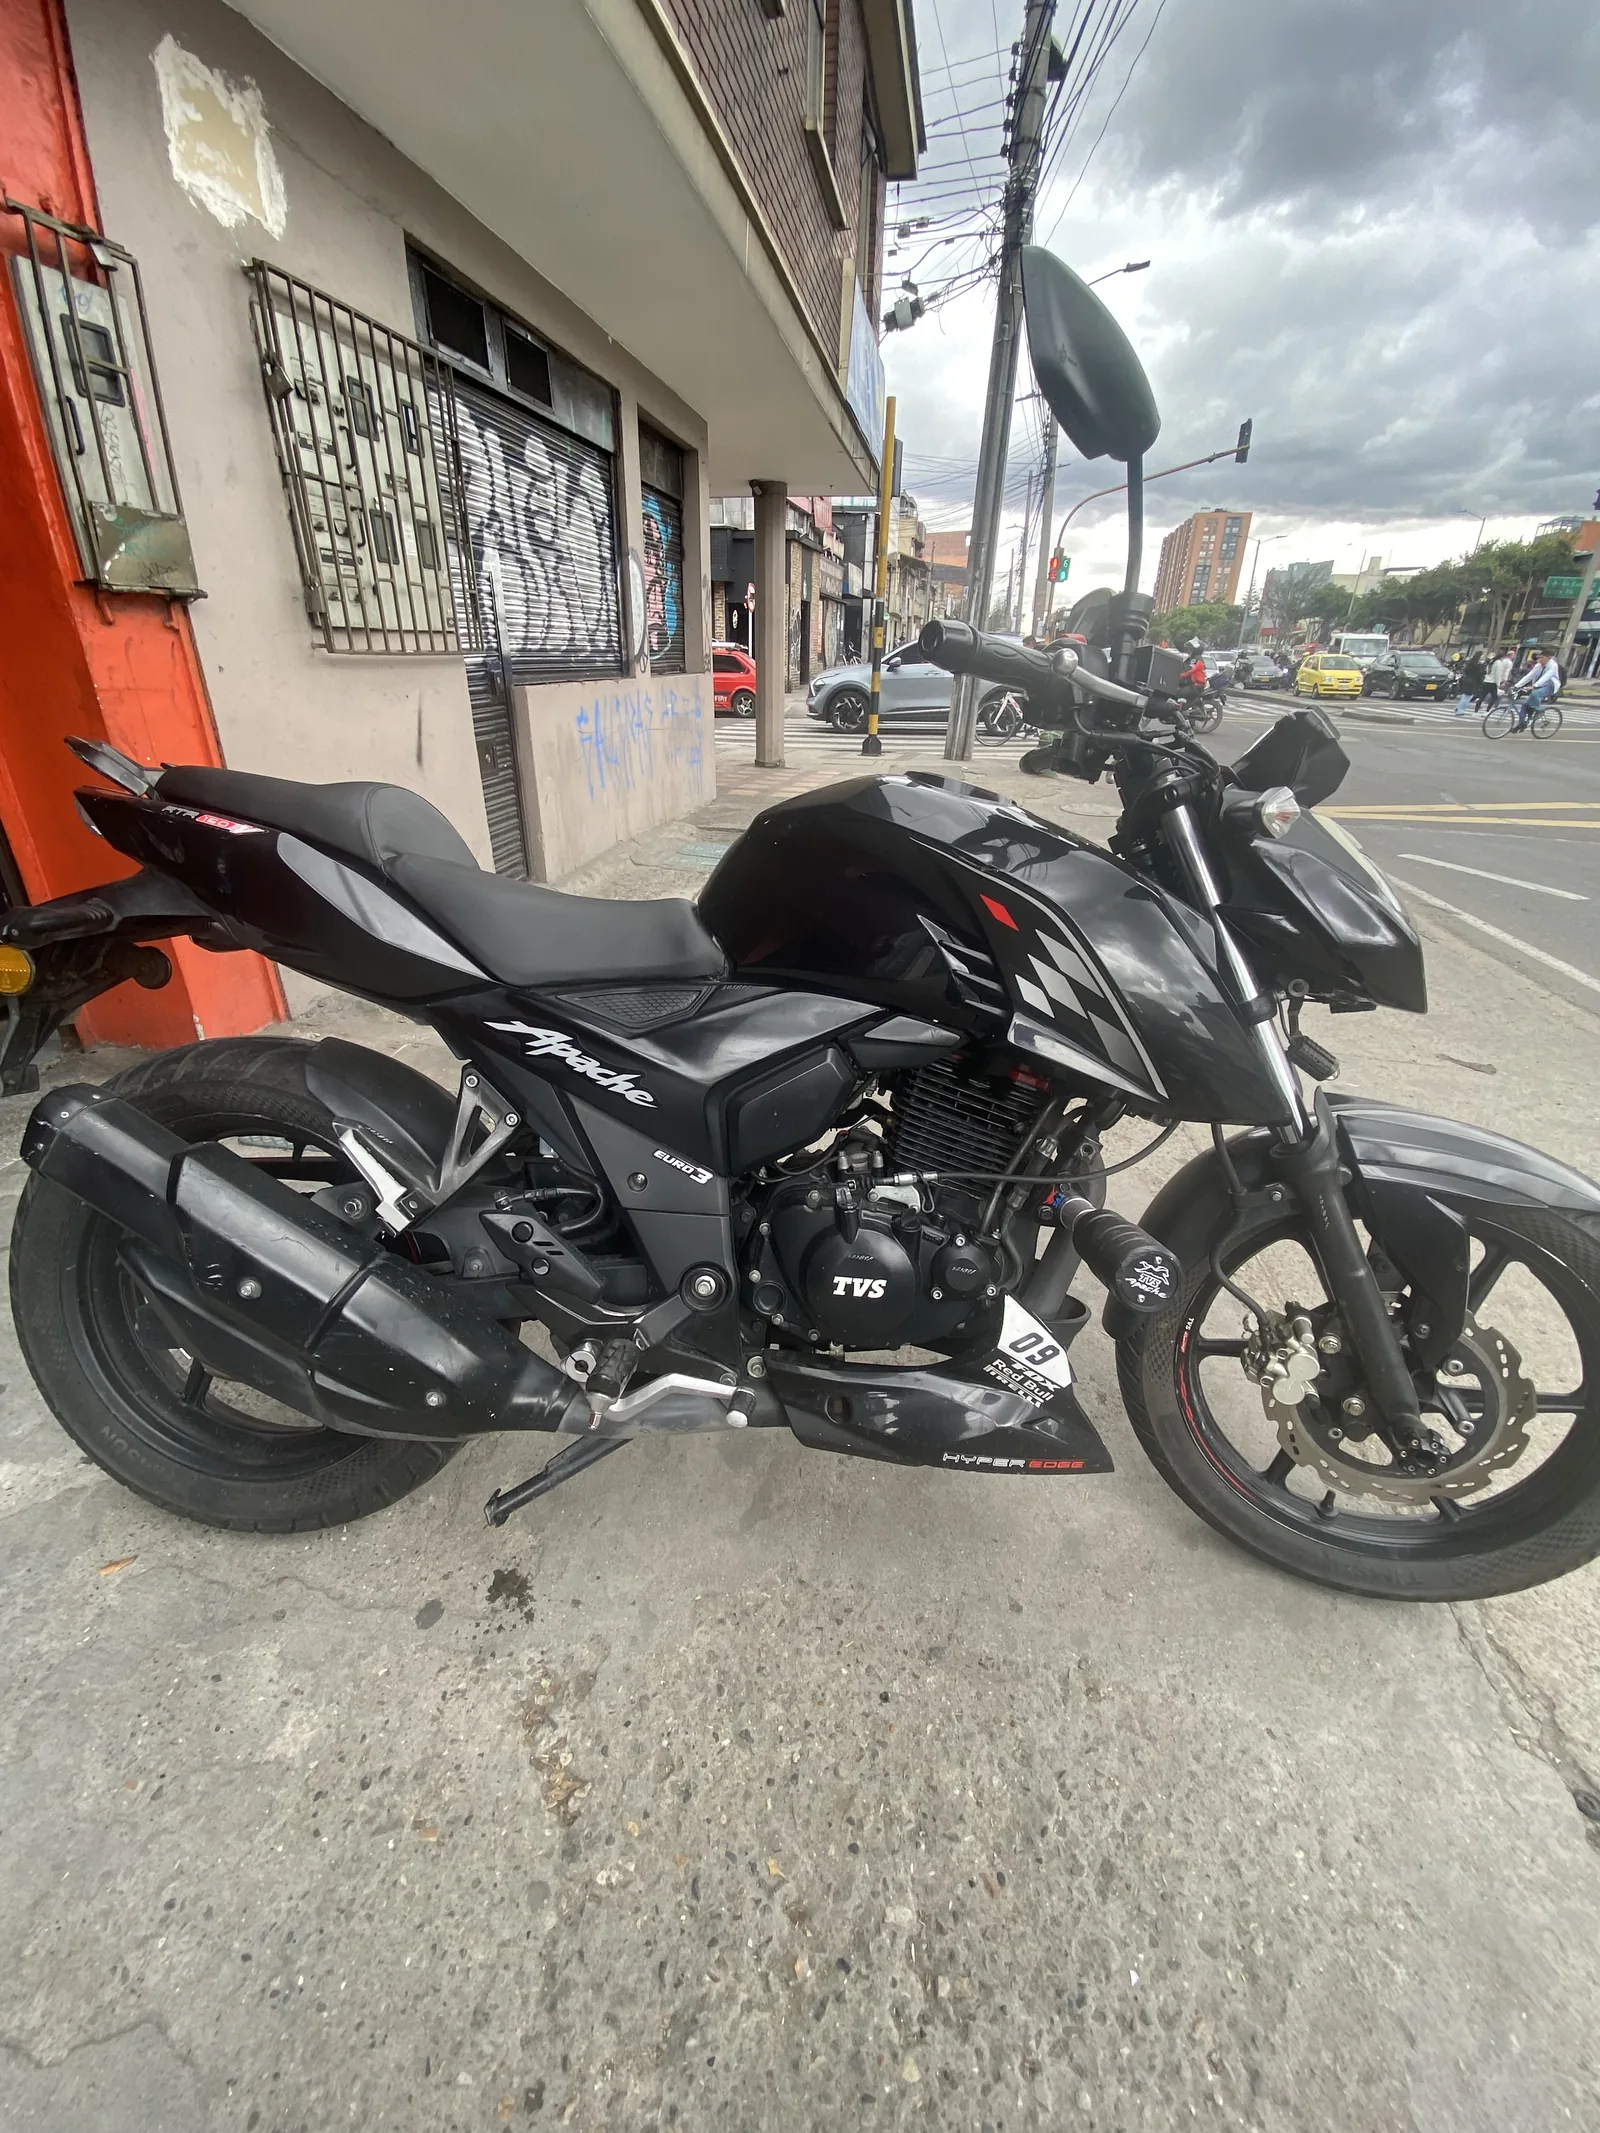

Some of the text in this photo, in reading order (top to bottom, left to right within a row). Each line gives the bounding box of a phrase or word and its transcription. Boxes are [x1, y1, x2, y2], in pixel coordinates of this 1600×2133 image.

[483, 1020, 659, 1109] Apache
[832, 1276, 888, 1299] TVS
[1138, 1273, 1161, 1288] TVS
[1183, 1317, 1195, 1331] TVS
[1009, 1332, 1060, 1365] 09
[992, 1359, 1055, 1401] Red Bull
[1010, 1357, 1061, 1392] FOX
[943, 1453, 1026, 1468] HYPER
